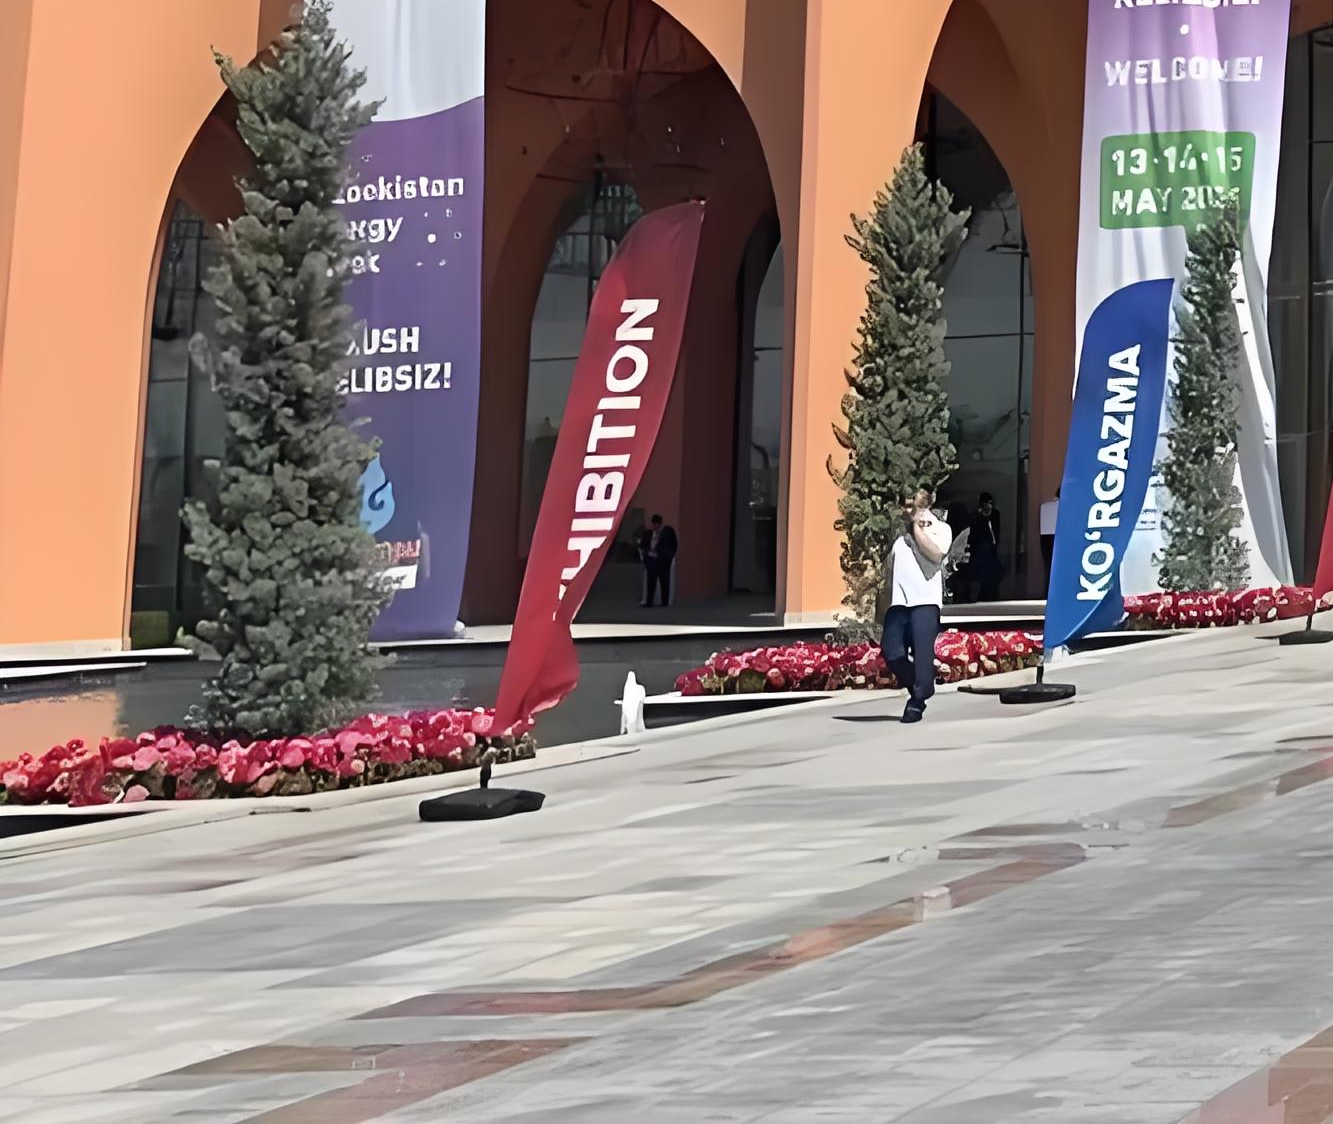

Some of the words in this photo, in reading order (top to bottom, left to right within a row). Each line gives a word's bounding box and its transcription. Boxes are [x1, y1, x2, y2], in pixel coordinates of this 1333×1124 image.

[1111, 186, 1172, 216] MAY
[335, 362, 452, 395] LIBSIZ!
[552, 298, 660, 622] HIBITION
